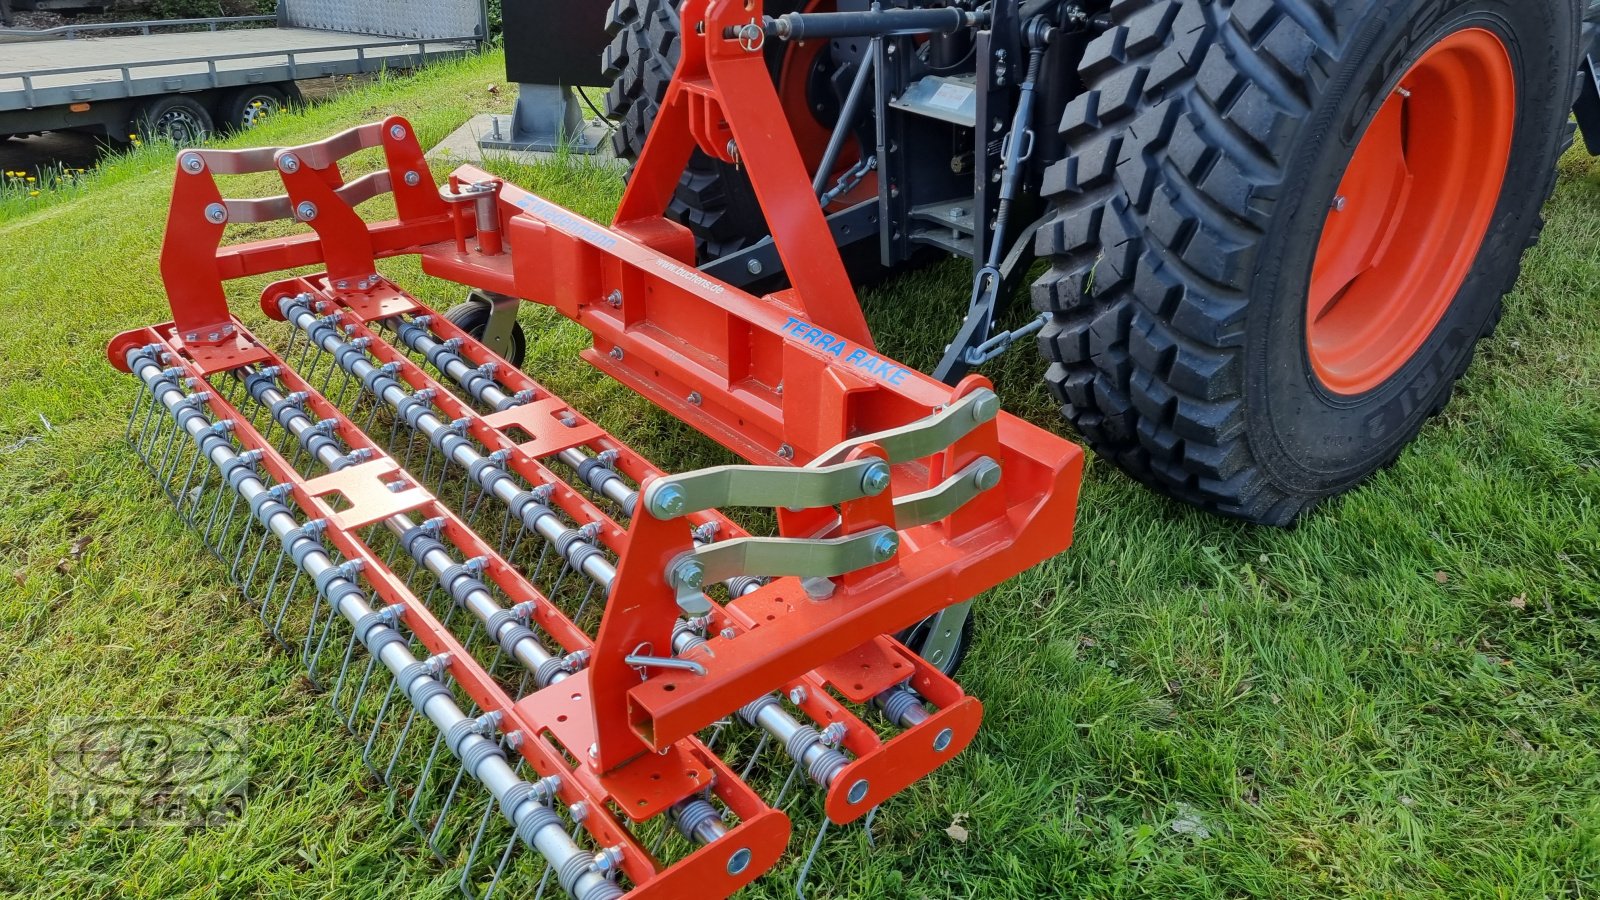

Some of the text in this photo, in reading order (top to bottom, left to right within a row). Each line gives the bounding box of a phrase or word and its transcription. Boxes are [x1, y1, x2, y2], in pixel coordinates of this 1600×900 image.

[656, 258, 724, 294] www.buchens.de
[781, 316, 912, 385] TERRA RAKE
